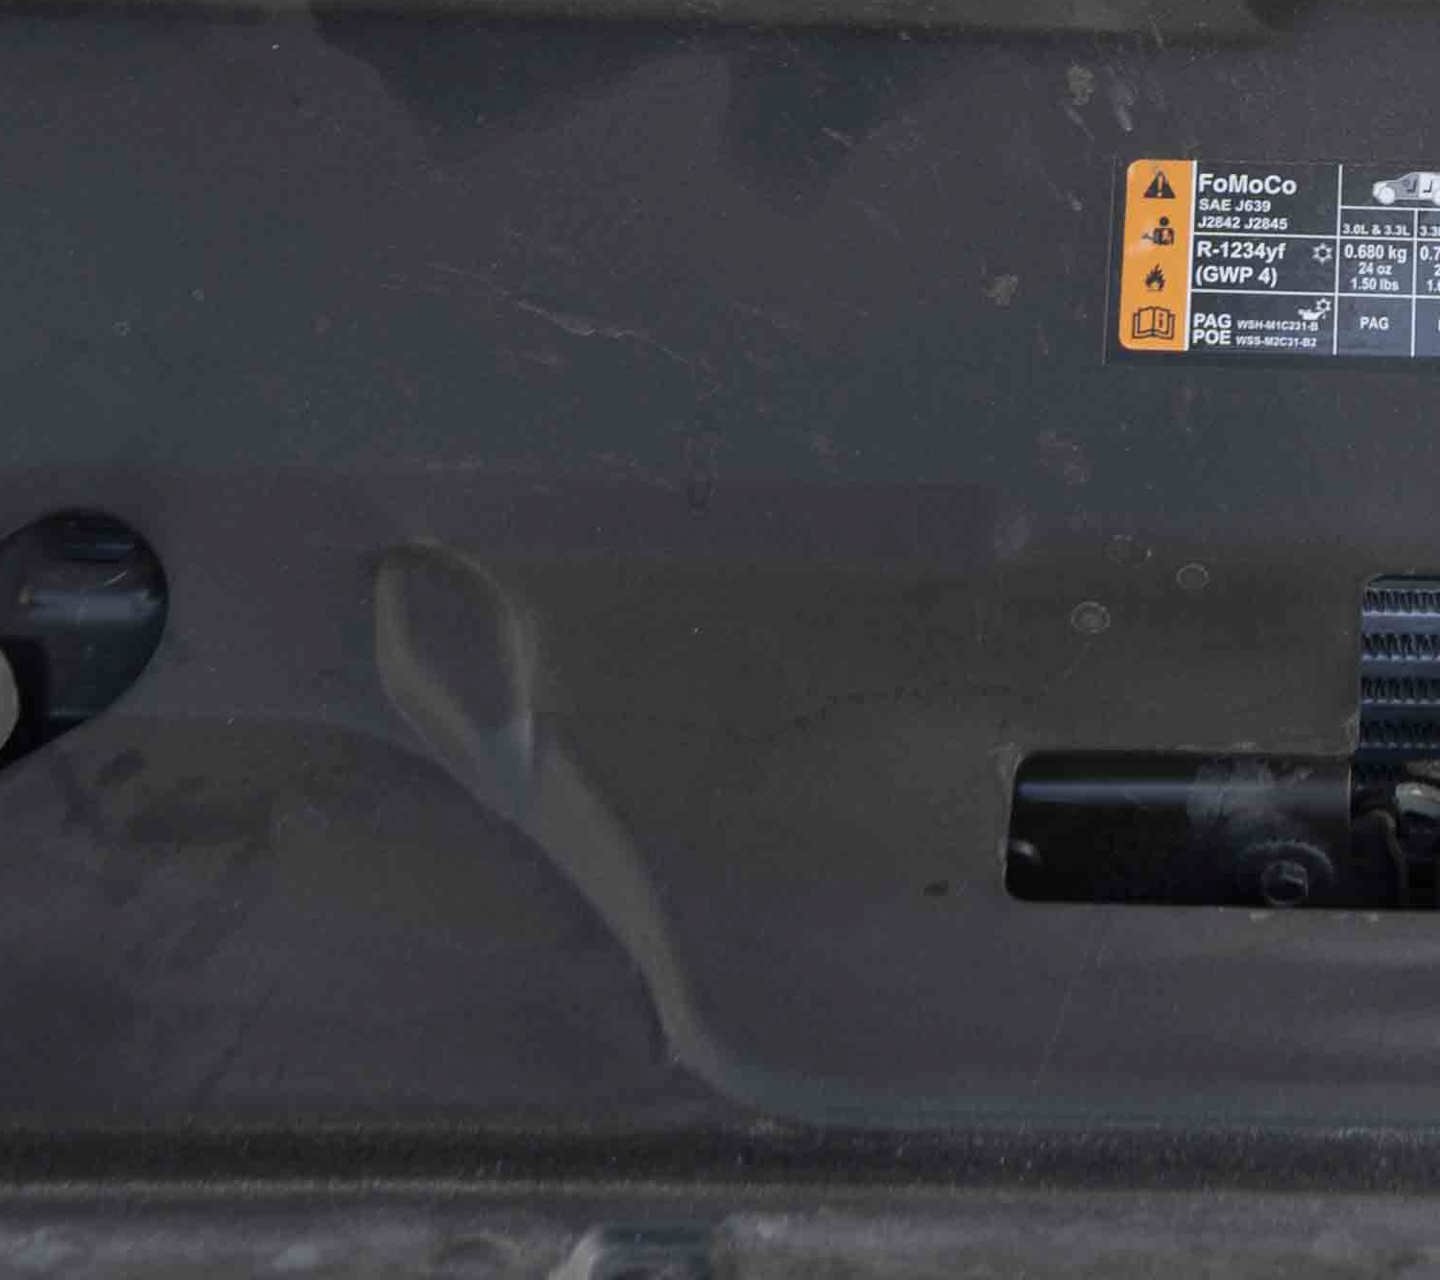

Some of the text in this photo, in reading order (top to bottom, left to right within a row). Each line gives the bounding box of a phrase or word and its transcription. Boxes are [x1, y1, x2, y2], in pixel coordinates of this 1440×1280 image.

[1198, 173, 1297, 195] FoMoCo
[1198, 198, 1272, 213] SAE J639
[1198, 216, 1288, 230] J2842 J2845
[1342, 223, 1411, 236] 3.0L & 3.3L
[1196, 240, 1287, 264] R-1234yf
[1344, 243, 1408, 263] 0.680 kg
[1195, 265, 1278, 288] (GWP 4)
[1358, 262, 1393, 276] 24 oz
[1351, 277, 1399, 291] 1.50 lbs
[1193, 312, 1232, 329] PAG
[1359, 315, 1390, 331] PAG
[1192, 329, 1232, 345] POE
